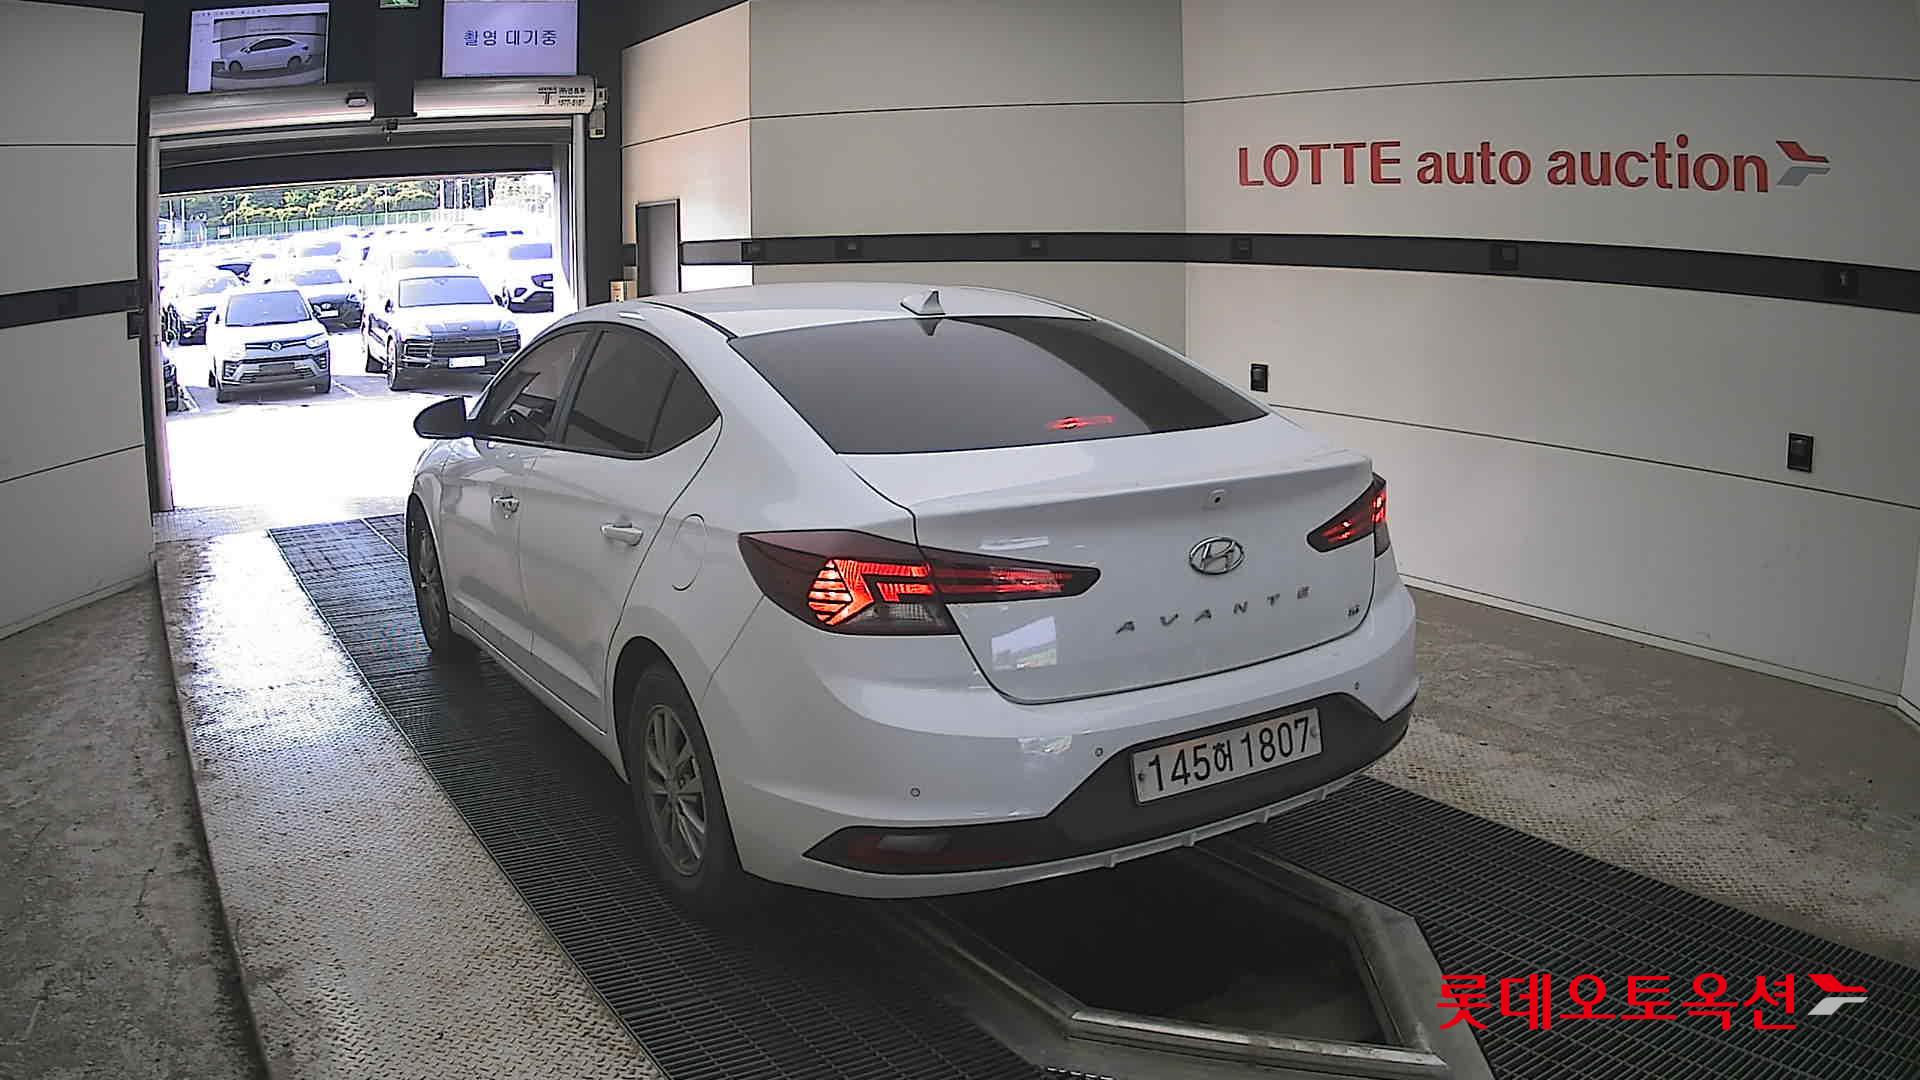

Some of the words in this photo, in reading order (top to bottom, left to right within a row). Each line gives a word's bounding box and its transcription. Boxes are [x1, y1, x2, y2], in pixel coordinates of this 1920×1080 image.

[505, 29, 557, 46] 대기중
[1239, 140, 1399, 187] LOTTE
[1417, 142, 1532, 186] auto
[1549, 134, 1769, 192] auction
[1115, 586, 1311, 635] AVANTE
[1241, 716, 1310, 768] 1807
